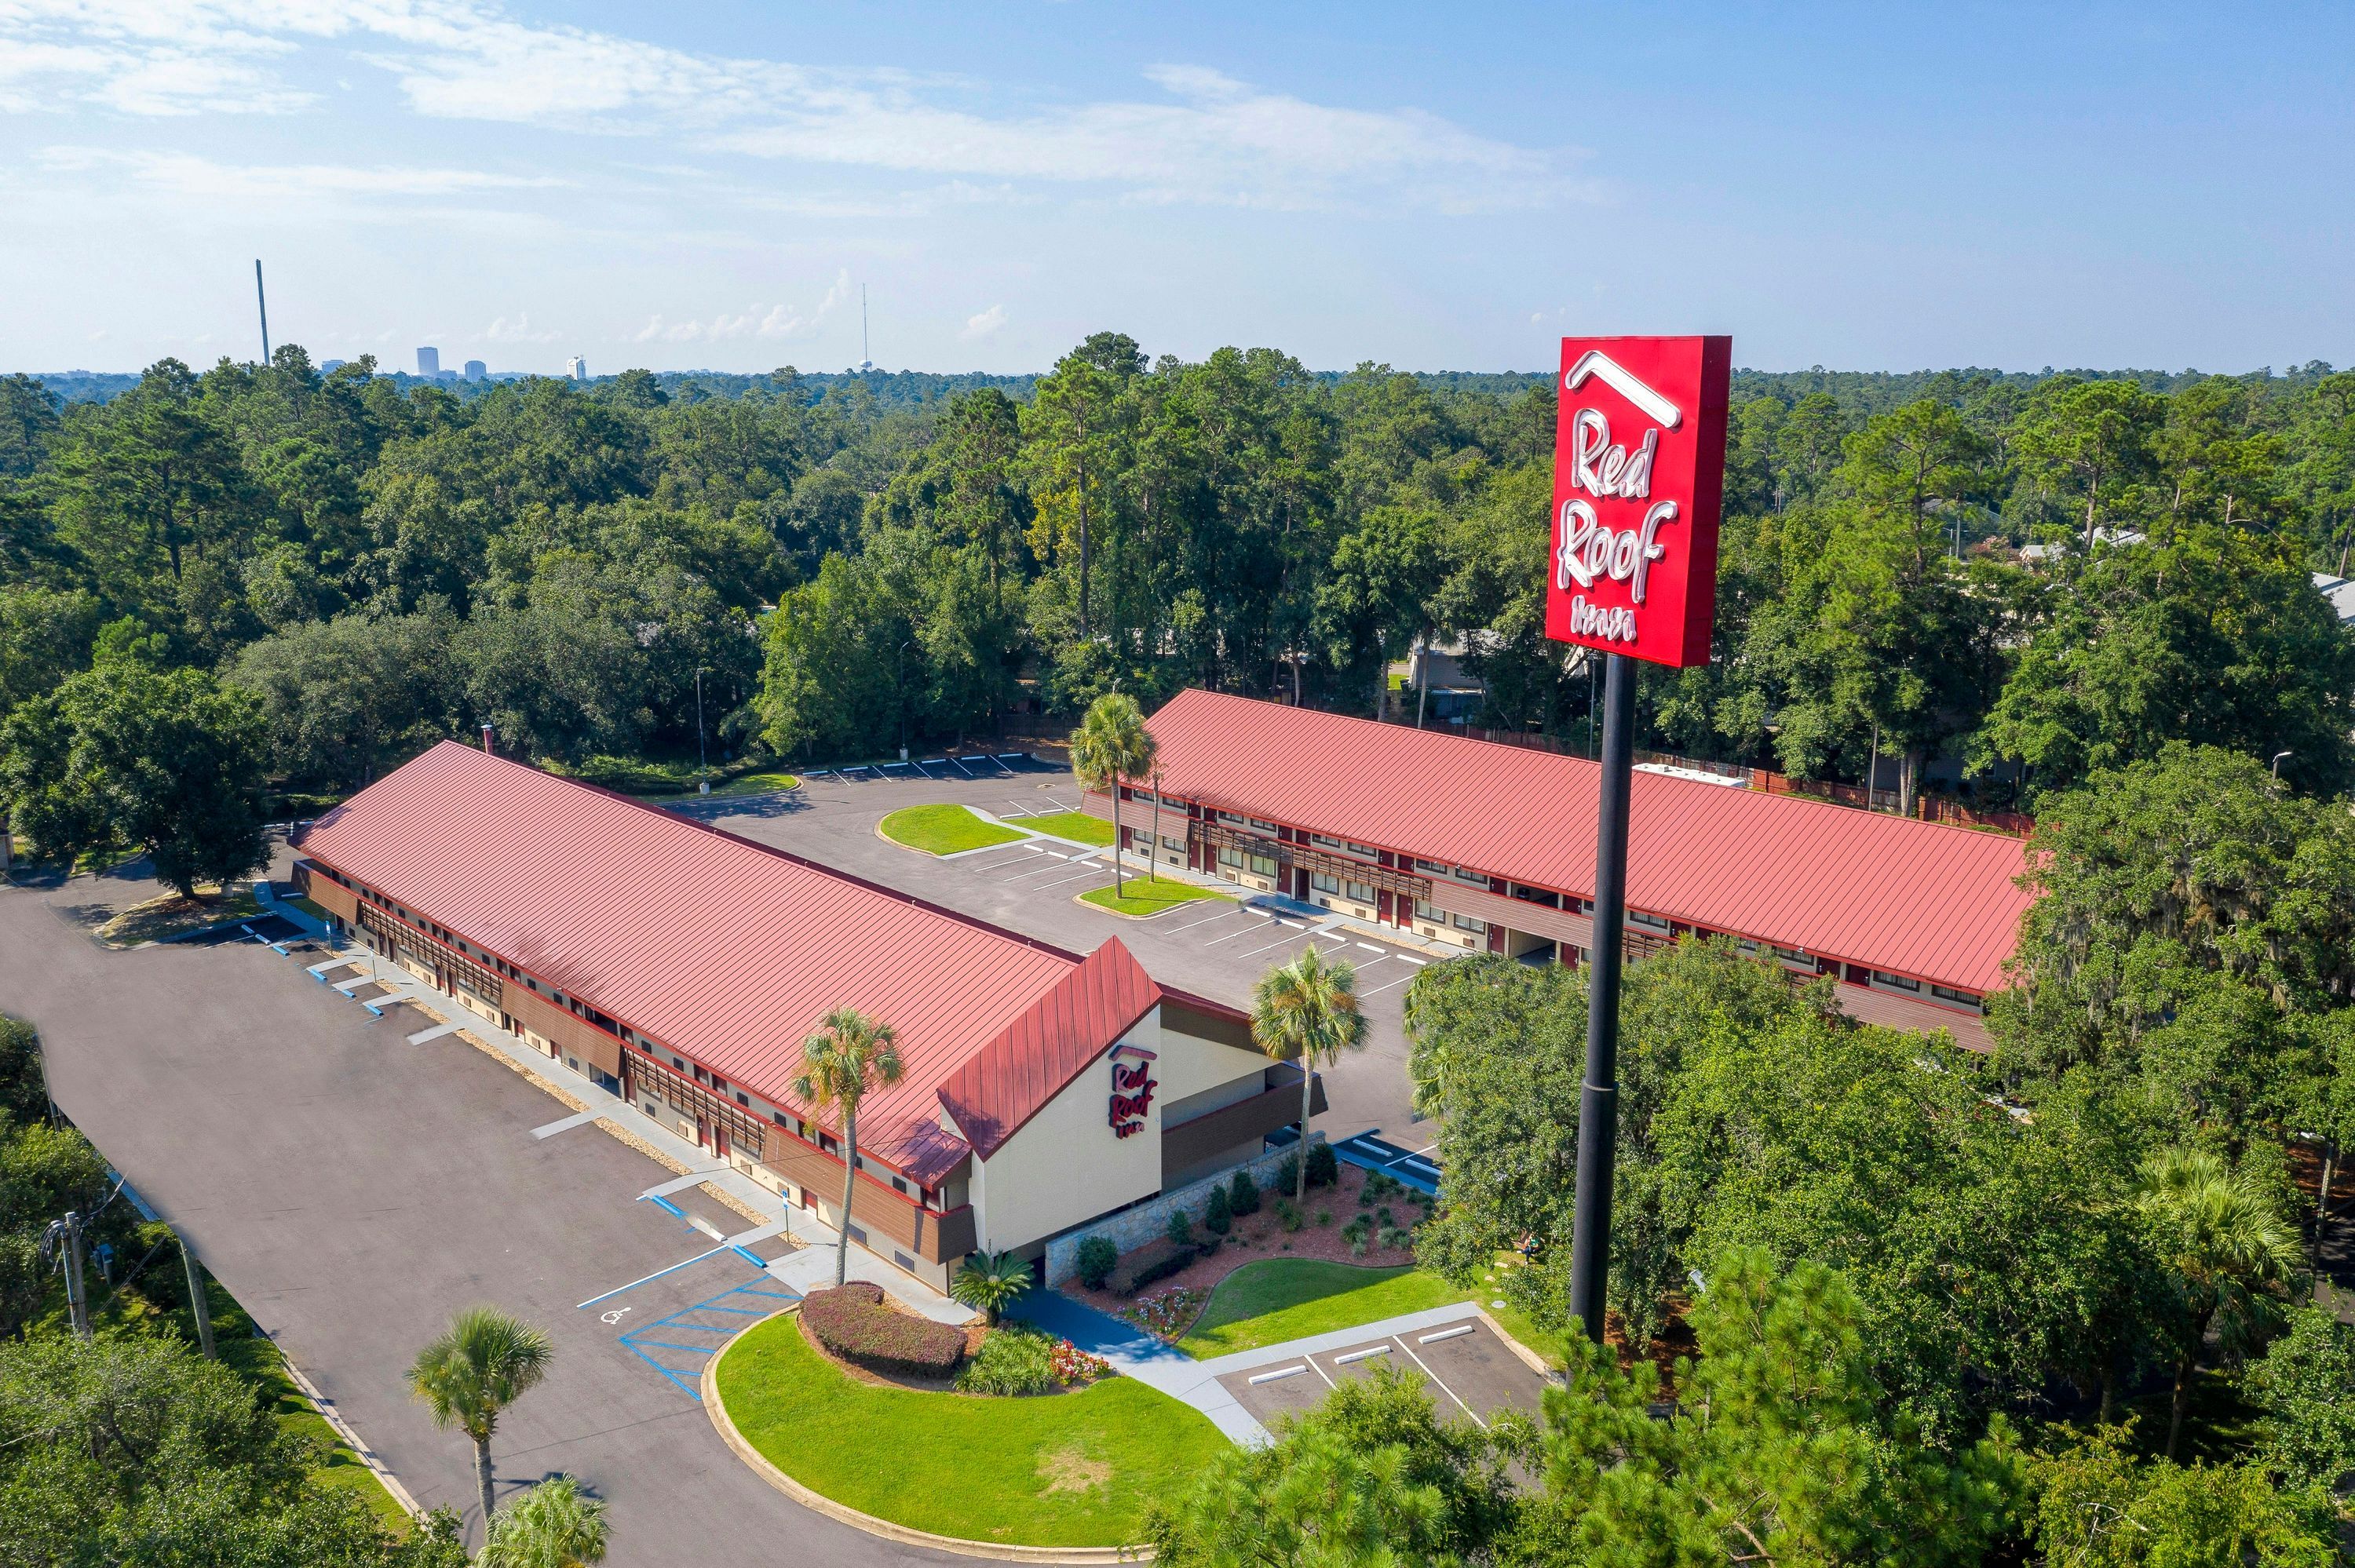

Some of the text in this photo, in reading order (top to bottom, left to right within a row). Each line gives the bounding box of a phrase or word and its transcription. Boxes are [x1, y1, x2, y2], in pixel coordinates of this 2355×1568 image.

[1572, 408, 1658, 498] Red
[1557, 499, 1678, 603] Roof
[1571, 595, 1637, 642] Inn
[1112, 1061, 1149, 1093] Red
[1108, 1080, 1158, 1129] Roof
